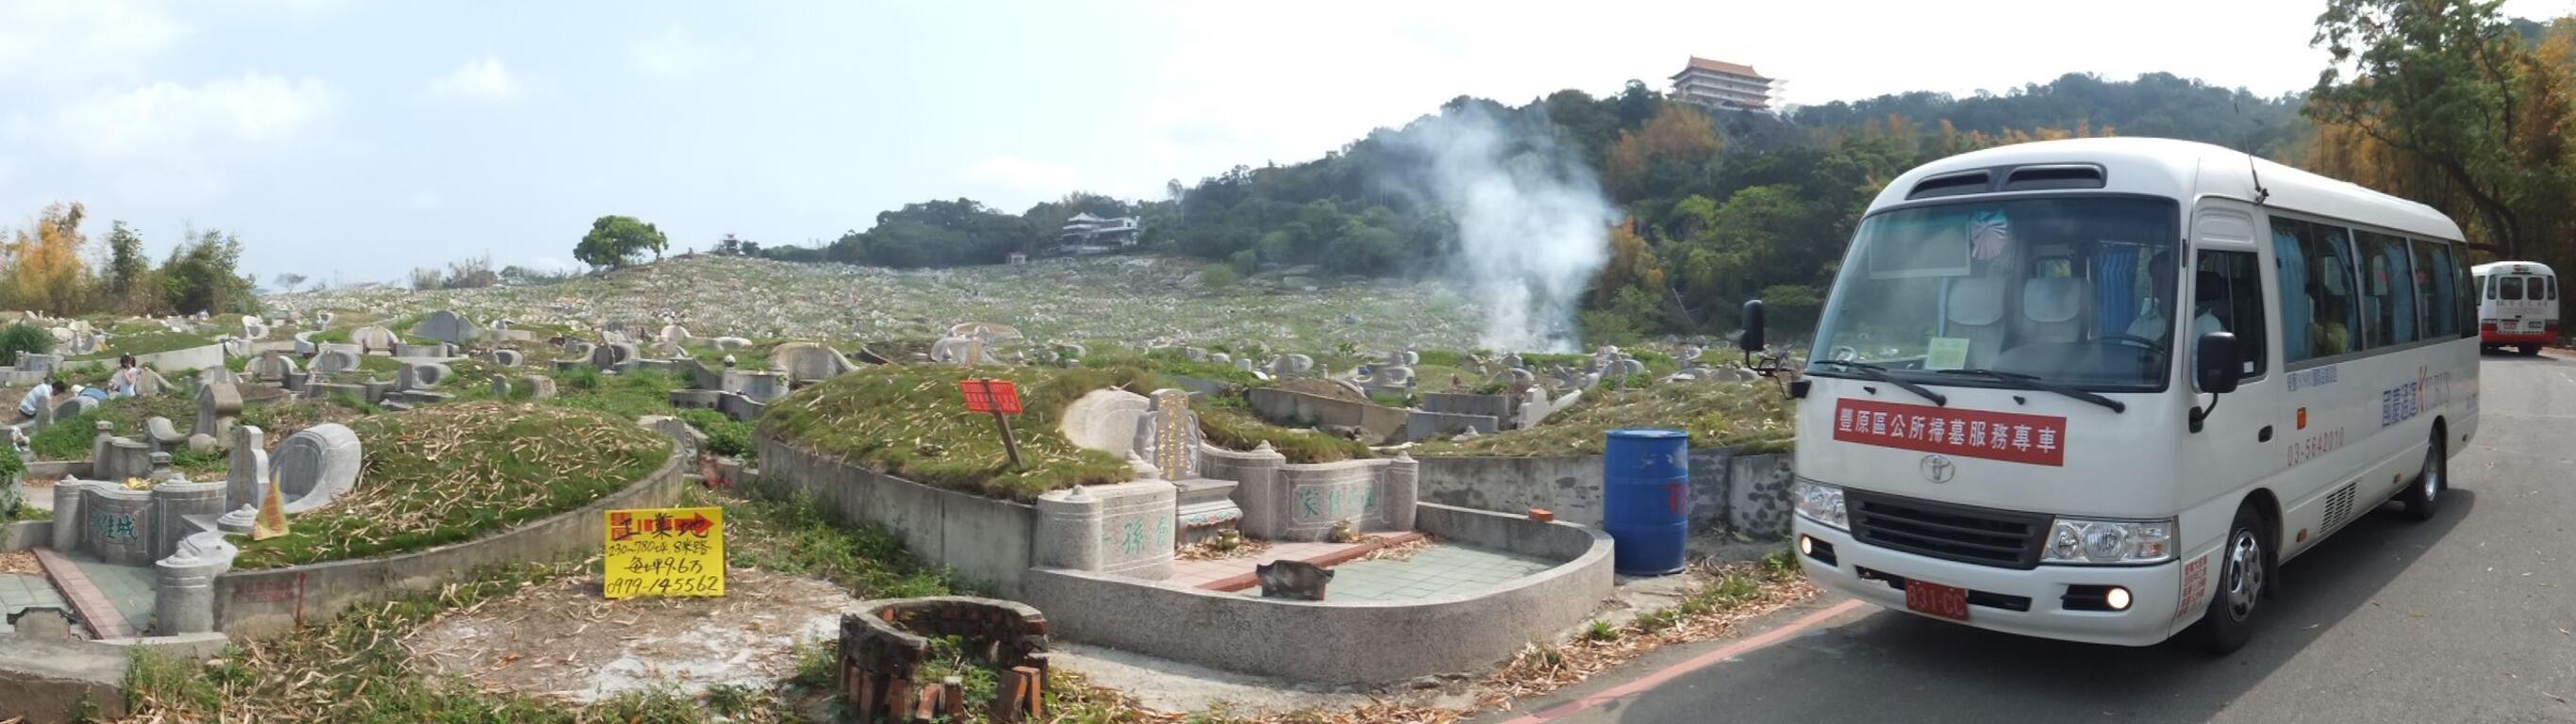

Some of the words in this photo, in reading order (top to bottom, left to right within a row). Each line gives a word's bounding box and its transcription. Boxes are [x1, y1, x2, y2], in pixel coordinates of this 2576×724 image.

[1838, 407, 2057, 452] 豐原區公所掃墓服務專車
[2287, 426, 2345, 467] 03-5642010
[607, 574, 718, 594] 0979-145562
